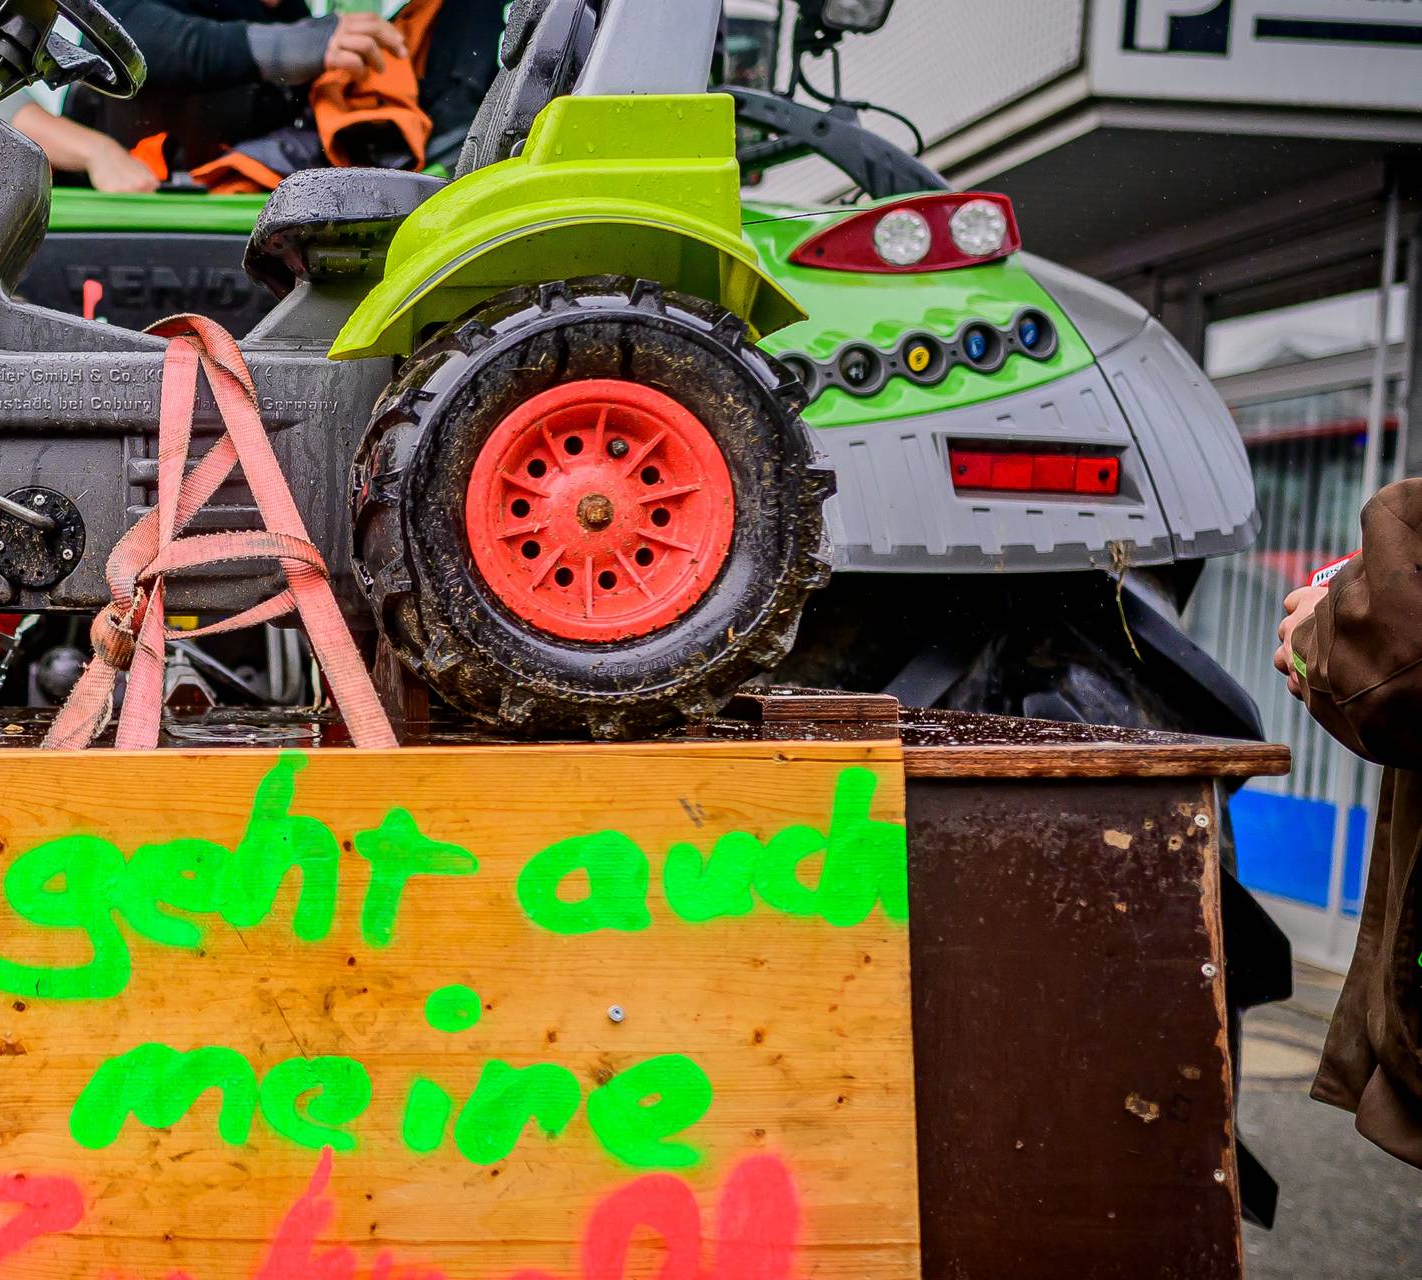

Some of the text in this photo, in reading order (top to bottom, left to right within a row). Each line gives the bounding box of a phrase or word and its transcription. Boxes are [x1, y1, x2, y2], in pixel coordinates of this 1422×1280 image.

[65, 264, 255, 306] FEND
[31, 368, 82, 383] GmbH
[90, 369, 102, 383] &
[59, 396, 84, 411] bei
[90, 396, 153, 414] Coburg
[261, 396, 338, 414] Germany
[515, 765, 909, 936] auch
[68, 984, 715, 1171] meine
